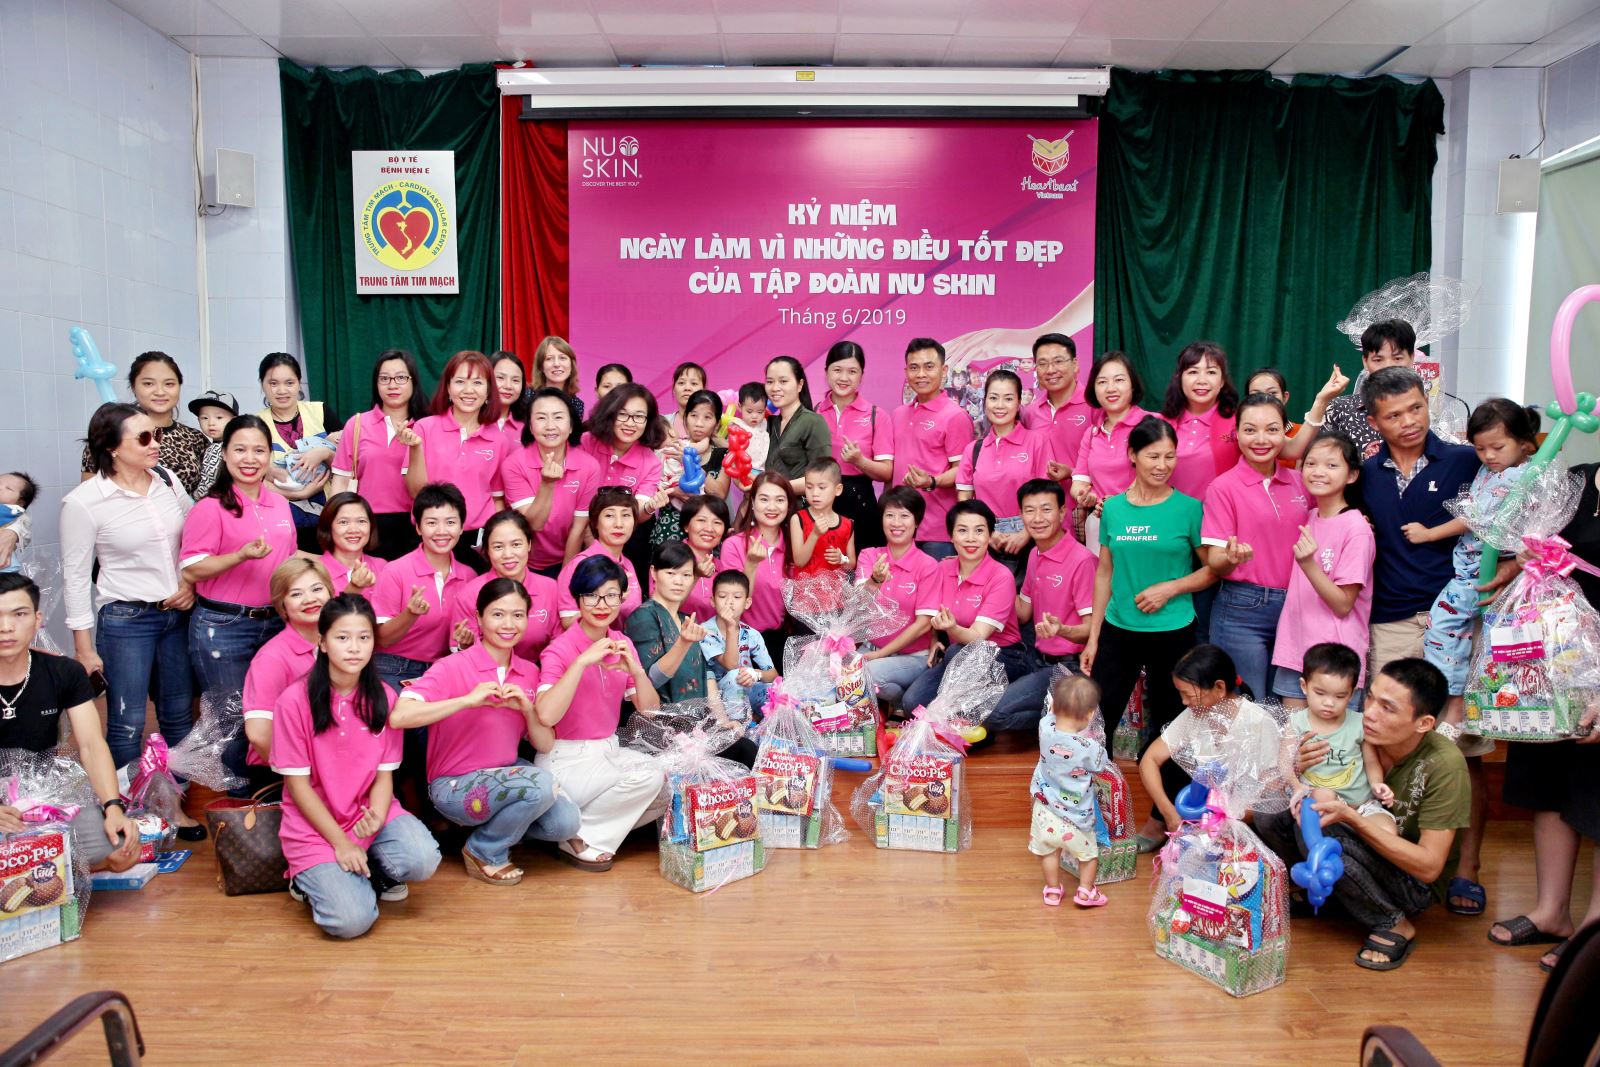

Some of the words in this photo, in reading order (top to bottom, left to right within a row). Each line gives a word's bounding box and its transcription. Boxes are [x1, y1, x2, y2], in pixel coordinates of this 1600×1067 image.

[583, 136, 616, 157] NU
[380, 166, 403, 174] BỆNH
[404, 166, 423, 175] VIỆN
[388, 156, 399, 164] BỘ
[374, 183, 394, 199] MẠCH
[365, 199, 375, 212] TIM
[399, 181, 448, 228] CARDIOVASCULAR
[787, 197, 822, 225] KỶ
[830, 198, 897, 231] NIỆM
[364, 232, 380, 256] TRUNG
[431, 228, 448, 256] CENTER
[620, 232, 686, 260] NGÀY
[694, 232, 751, 260] LÀM
[759, 233, 785, 260] VÌ
[793, 232, 885, 261] NHỮNG
[892, 228, 950, 261] ĐIỀU
[957, 229, 1008, 262] TỐT
[1015, 240, 1064, 268] ĐẸP
[359, 276, 388, 286] TRUNG
[390, 274, 409, 286] TÂM
[411, 276, 427, 286] TIM
[429, 276, 455, 288] MẠCH
[688, 265, 742, 294] CỦA
[750, 267, 801, 300] TẬP
[808, 268, 880, 295] ĐOÀN
[888, 273, 925, 295] NU
[932, 273, 996, 296] SKIN
[777, 308, 837, 329] Tháng
[841, 308, 906, 325] 6/2019
[1125, 525, 1151, 534] VEPT
